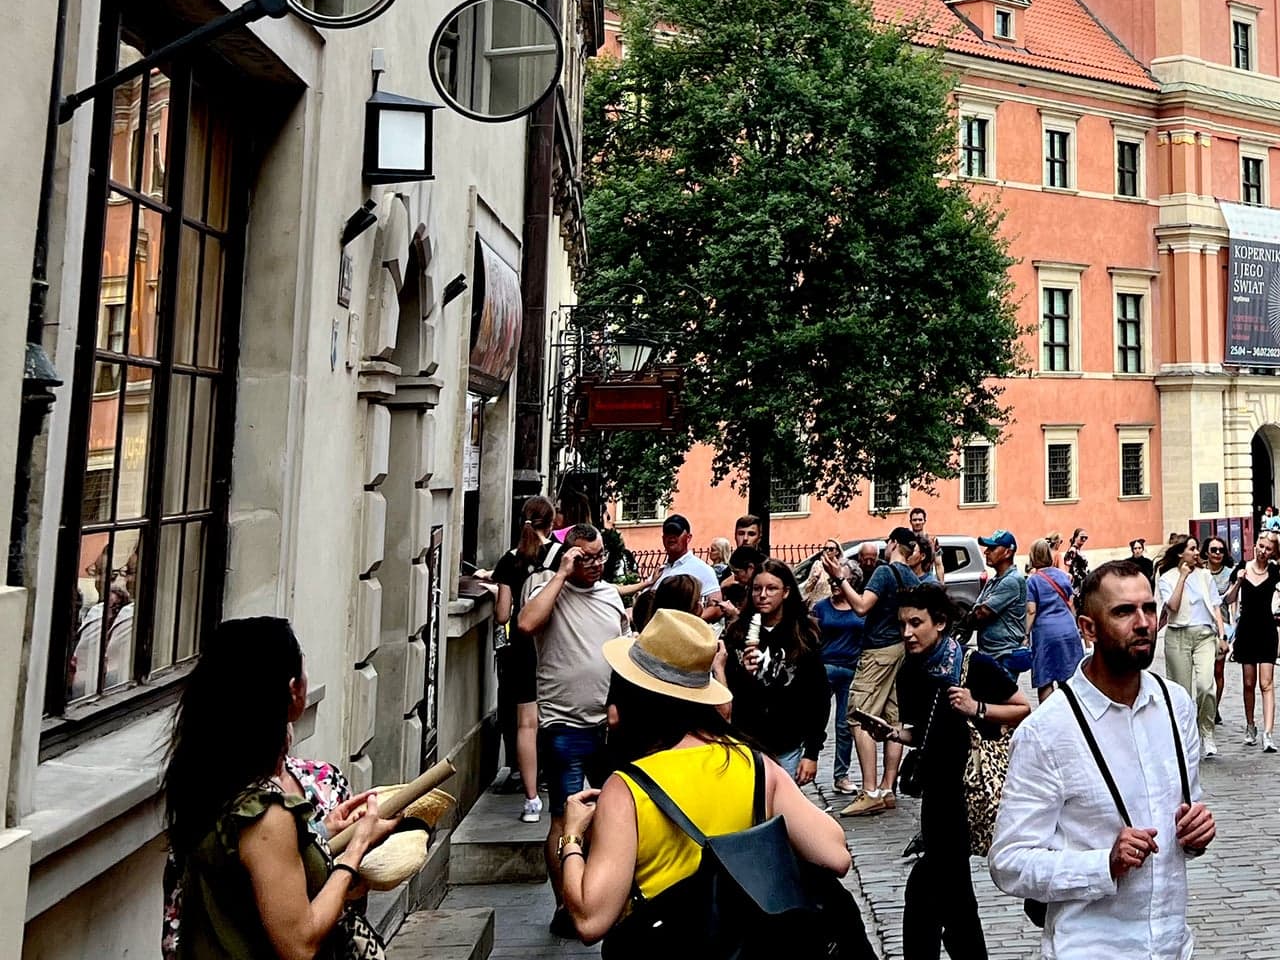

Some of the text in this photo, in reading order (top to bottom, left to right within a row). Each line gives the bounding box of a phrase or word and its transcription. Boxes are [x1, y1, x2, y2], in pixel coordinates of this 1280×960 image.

[1233, 262, 1264, 279] I JEGO
[1233, 276, 1265, 295] ŚWIAT
